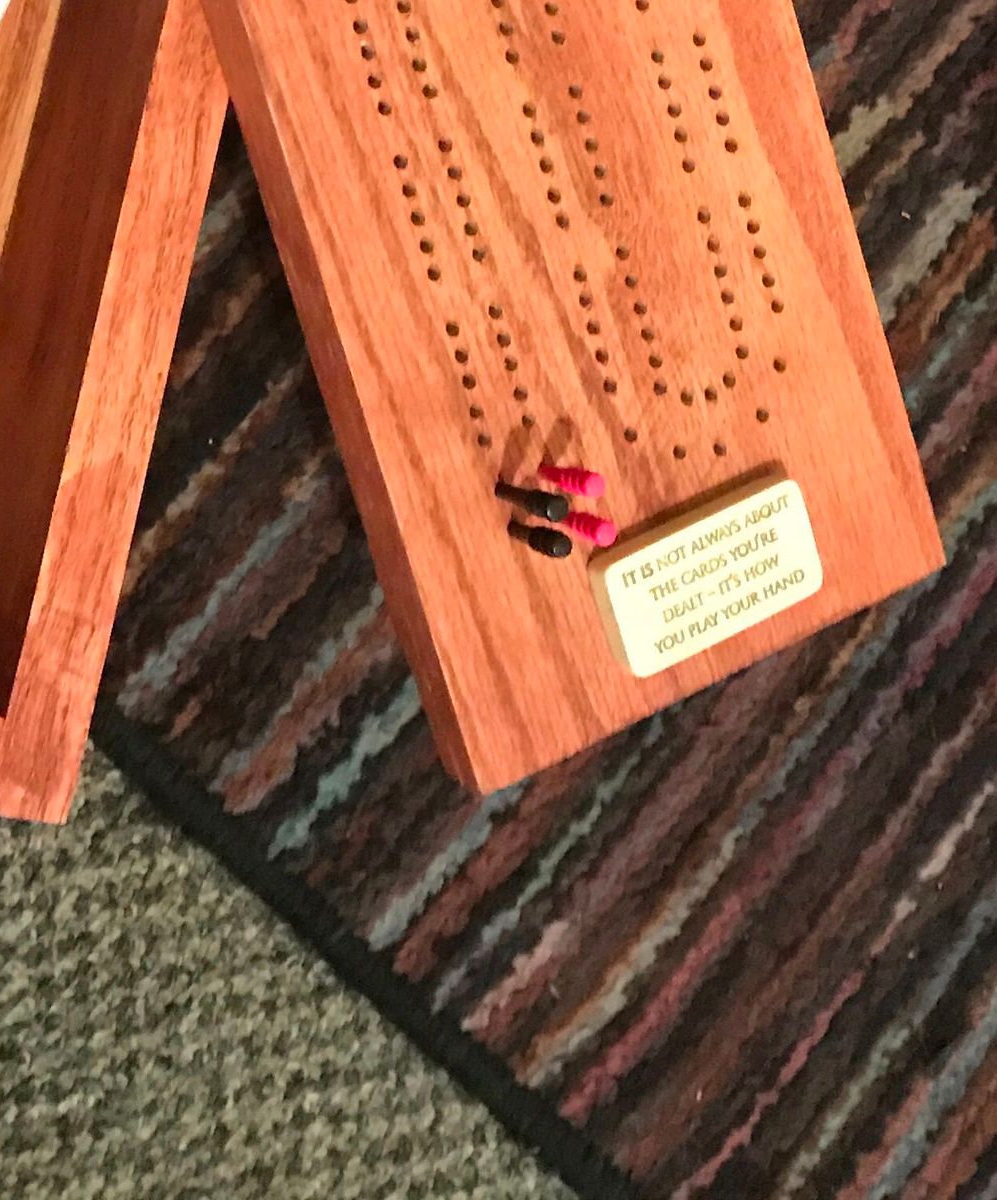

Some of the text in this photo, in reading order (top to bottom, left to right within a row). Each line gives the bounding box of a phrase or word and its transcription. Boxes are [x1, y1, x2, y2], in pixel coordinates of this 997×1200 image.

[621, 495, 790, 588] IT IS NOT ALWAYS ABOUT
[649, 527, 780, 602] THE CARDS YOU'RE
[654, 569, 806, 655] YOU PLAY YOUR HAND
[662, 592, 705, 624] DEALT
[718, 572, 742, 597] IT'S
[743, 554, 780, 583] HOW
